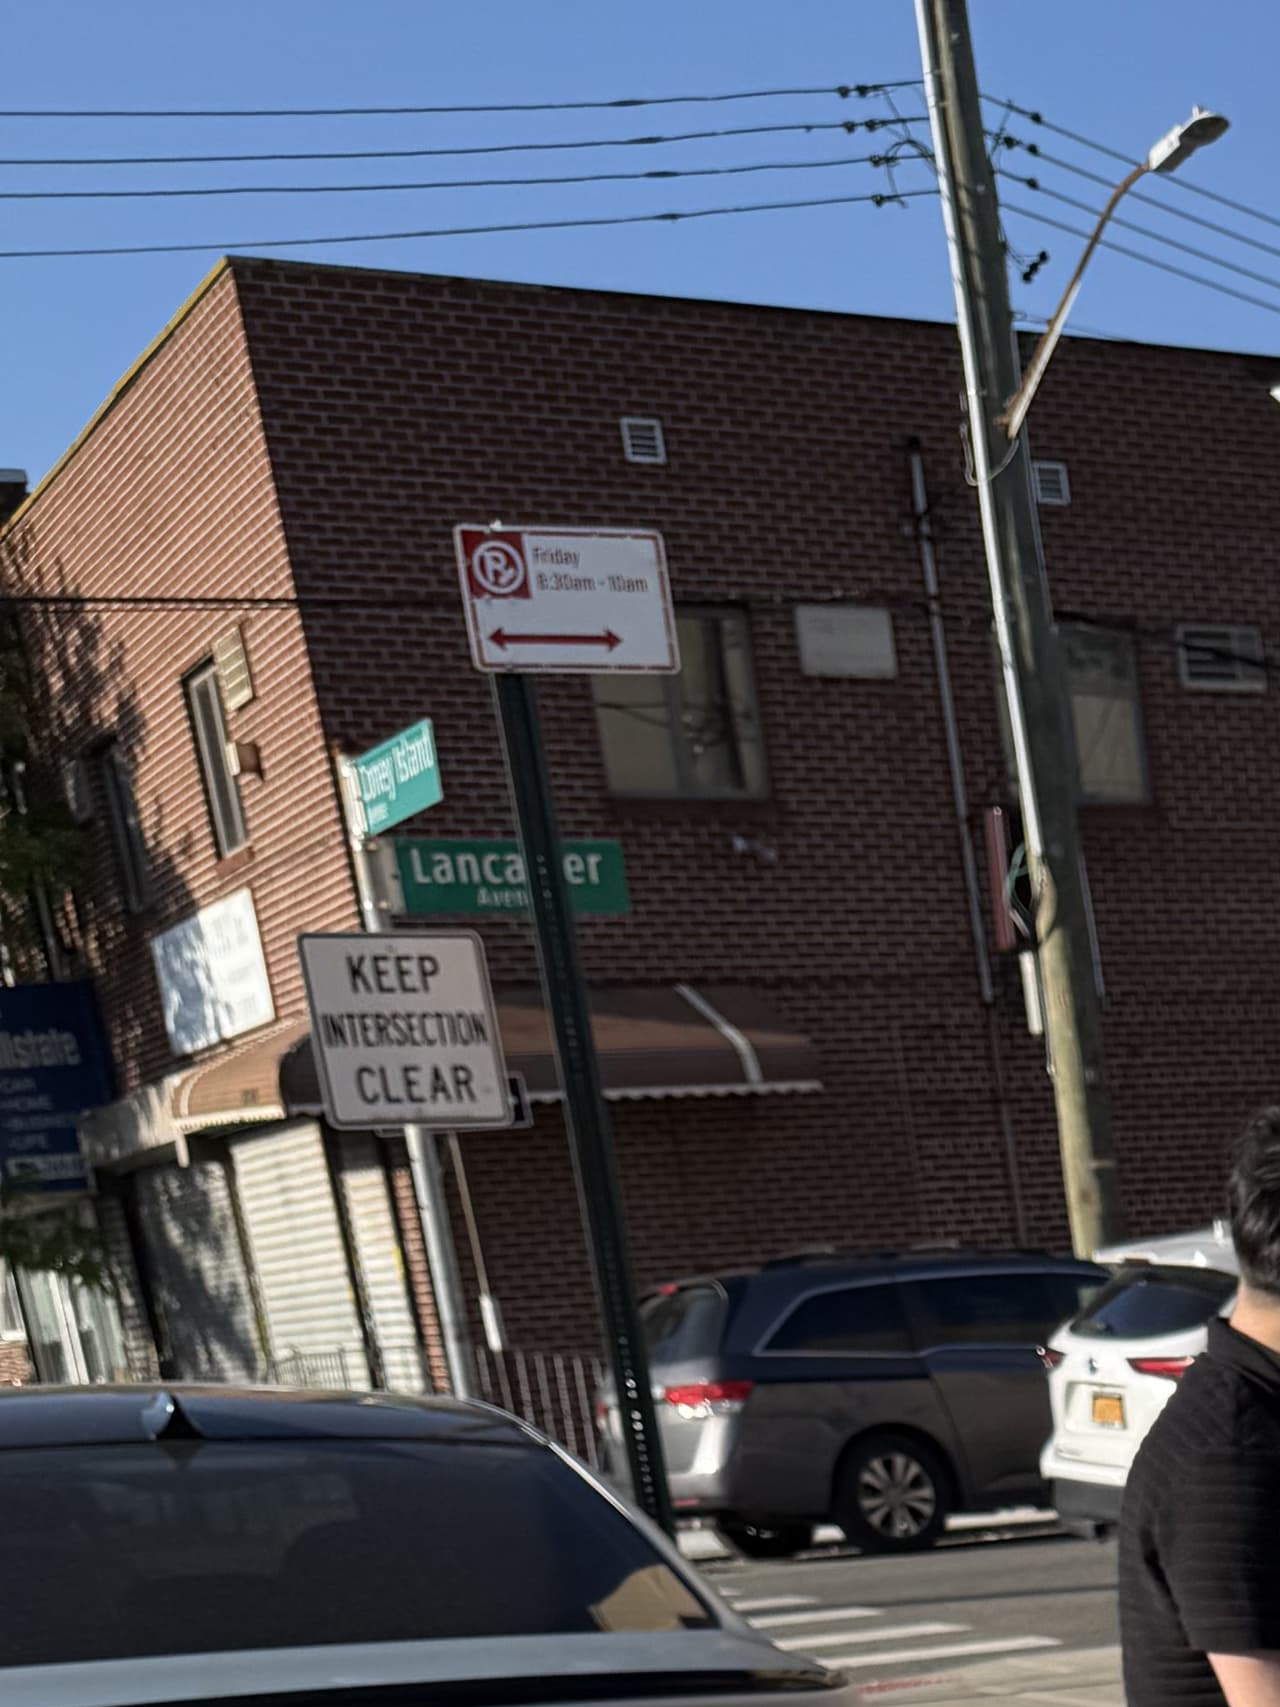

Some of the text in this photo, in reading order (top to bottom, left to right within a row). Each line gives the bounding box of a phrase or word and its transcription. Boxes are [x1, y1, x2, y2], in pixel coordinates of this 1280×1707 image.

[532, 547, 581, 568] Friday
[608, 575, 649, 592] 10am
[410, 848, 602, 885] Lancaer
[477, 888, 530, 908] Aven
[346, 954, 440, 994] KEEP
[320, 1011, 489, 1050] INTERSECTION
[356, 1064, 477, 1105] CLEAR
